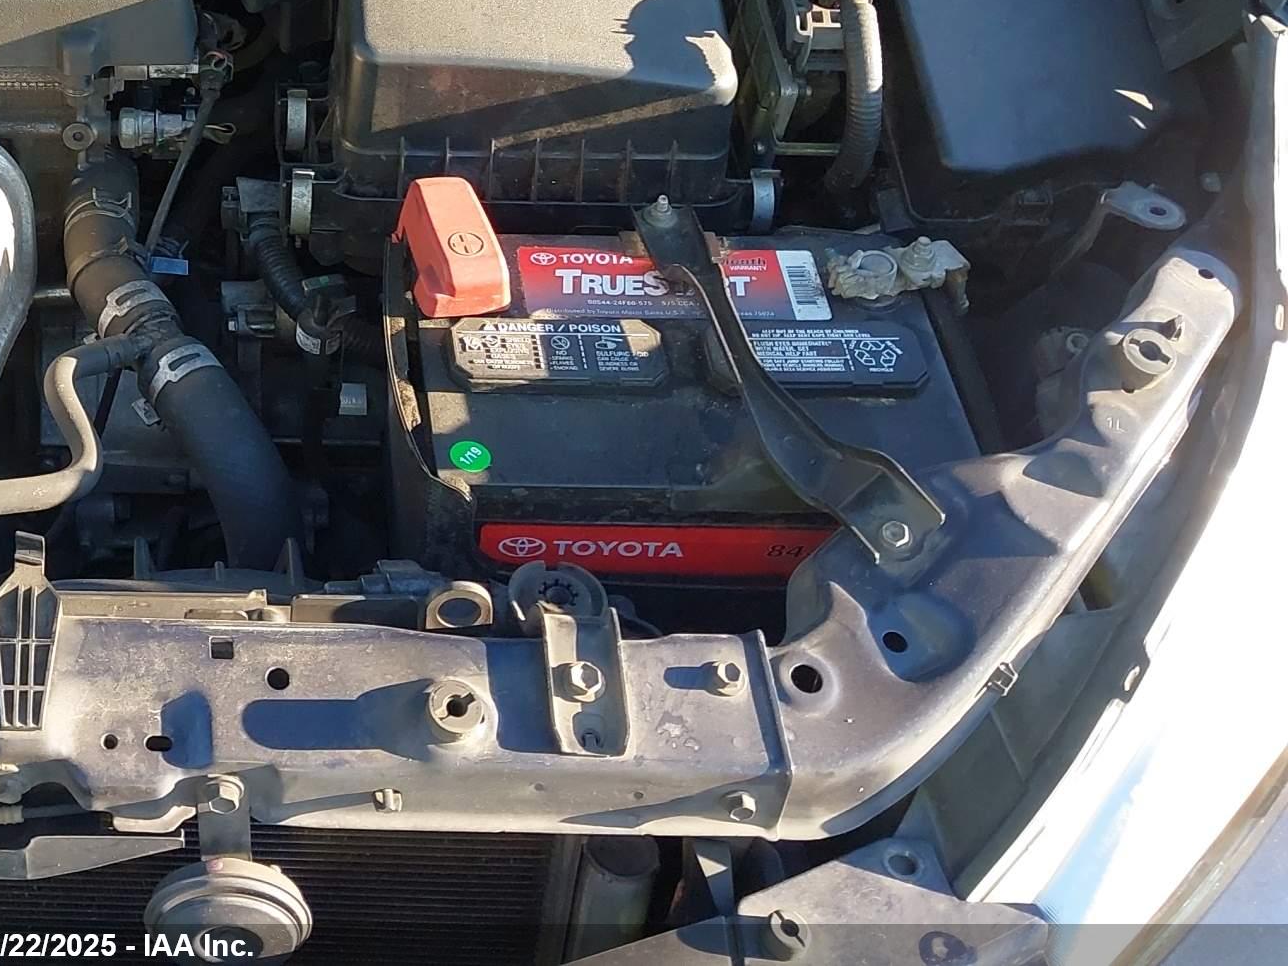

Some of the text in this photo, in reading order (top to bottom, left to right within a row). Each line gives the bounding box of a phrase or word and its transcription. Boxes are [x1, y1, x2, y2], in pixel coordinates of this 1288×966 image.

[559, 253, 633, 265] TOYOTA
[498, 323, 556, 332] DANGER
[571, 324, 621, 333] POISON
[459, 446, 482, 465] 1/19
[553, 540, 683, 557] TOYOTA
